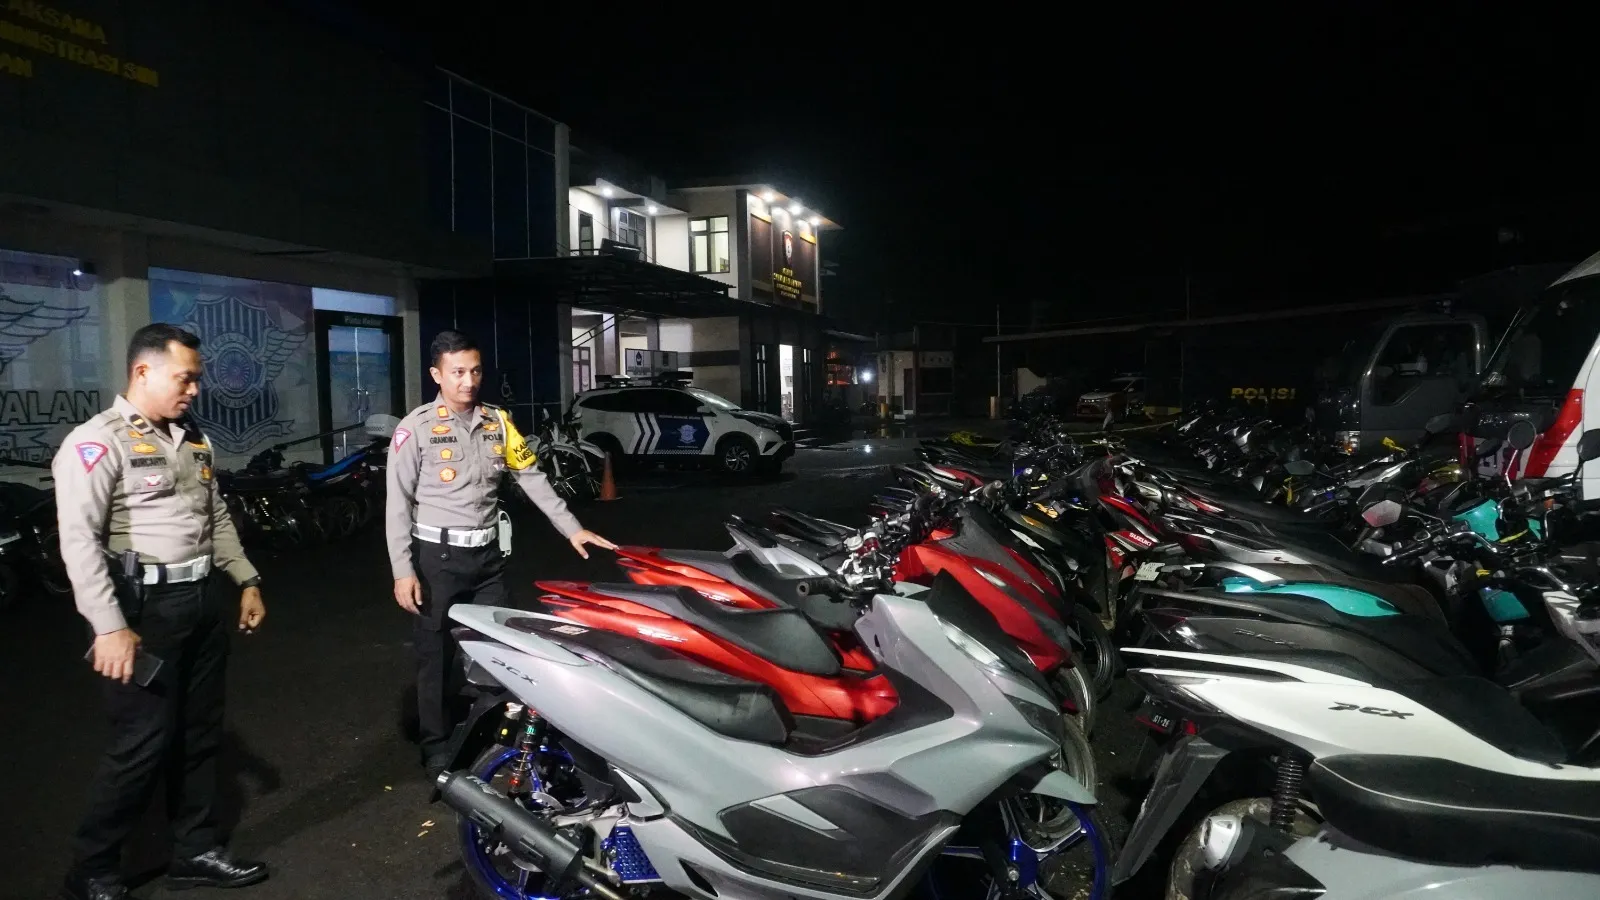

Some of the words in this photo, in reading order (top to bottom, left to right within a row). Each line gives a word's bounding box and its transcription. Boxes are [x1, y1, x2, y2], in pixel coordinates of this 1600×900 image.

[1230, 387, 1297, 400] POLISI
[0, 390, 101, 425] ALAN
[1128, 532, 1153, 547] SUZUKI
[491, 656, 540, 687] PCX
[1328, 701, 1415, 720] PCX
